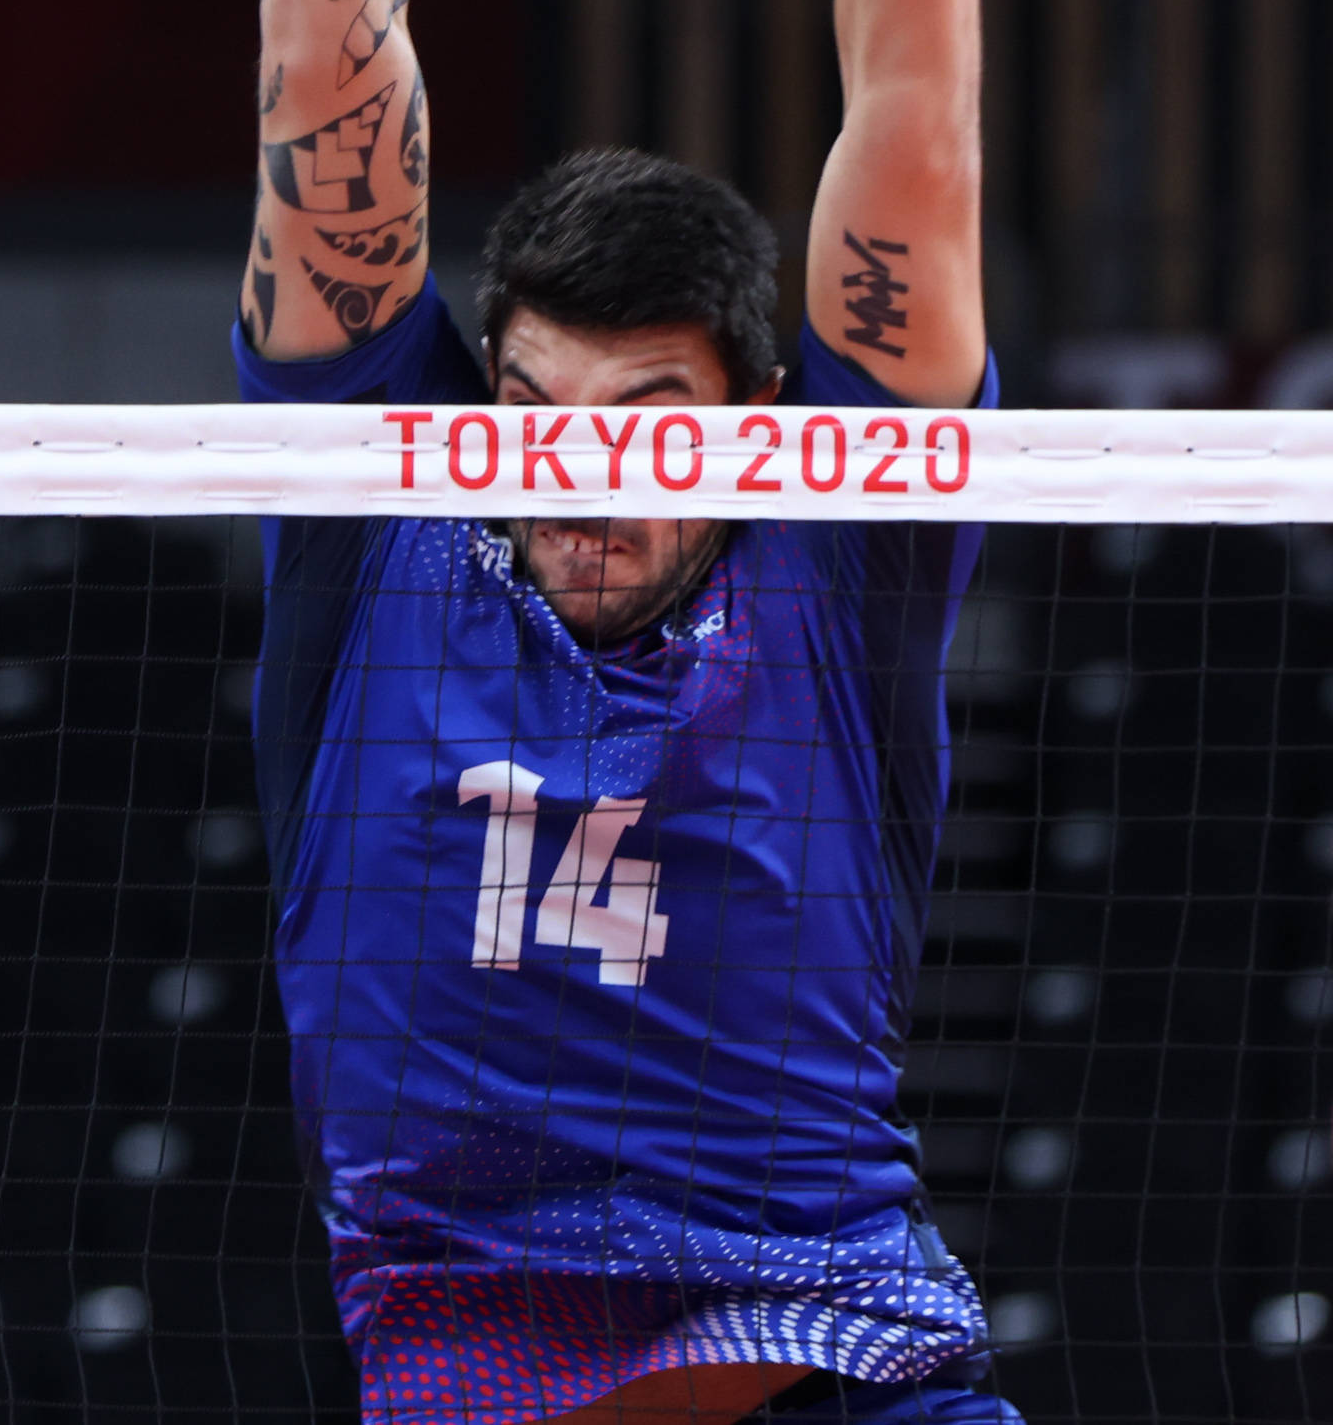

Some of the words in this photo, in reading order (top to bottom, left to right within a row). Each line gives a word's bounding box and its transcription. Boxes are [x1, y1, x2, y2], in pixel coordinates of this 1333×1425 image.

[381, 410, 704, 492] TOKYO
[735, 413, 971, 494] 2020
[457, 759, 670, 986] 14
